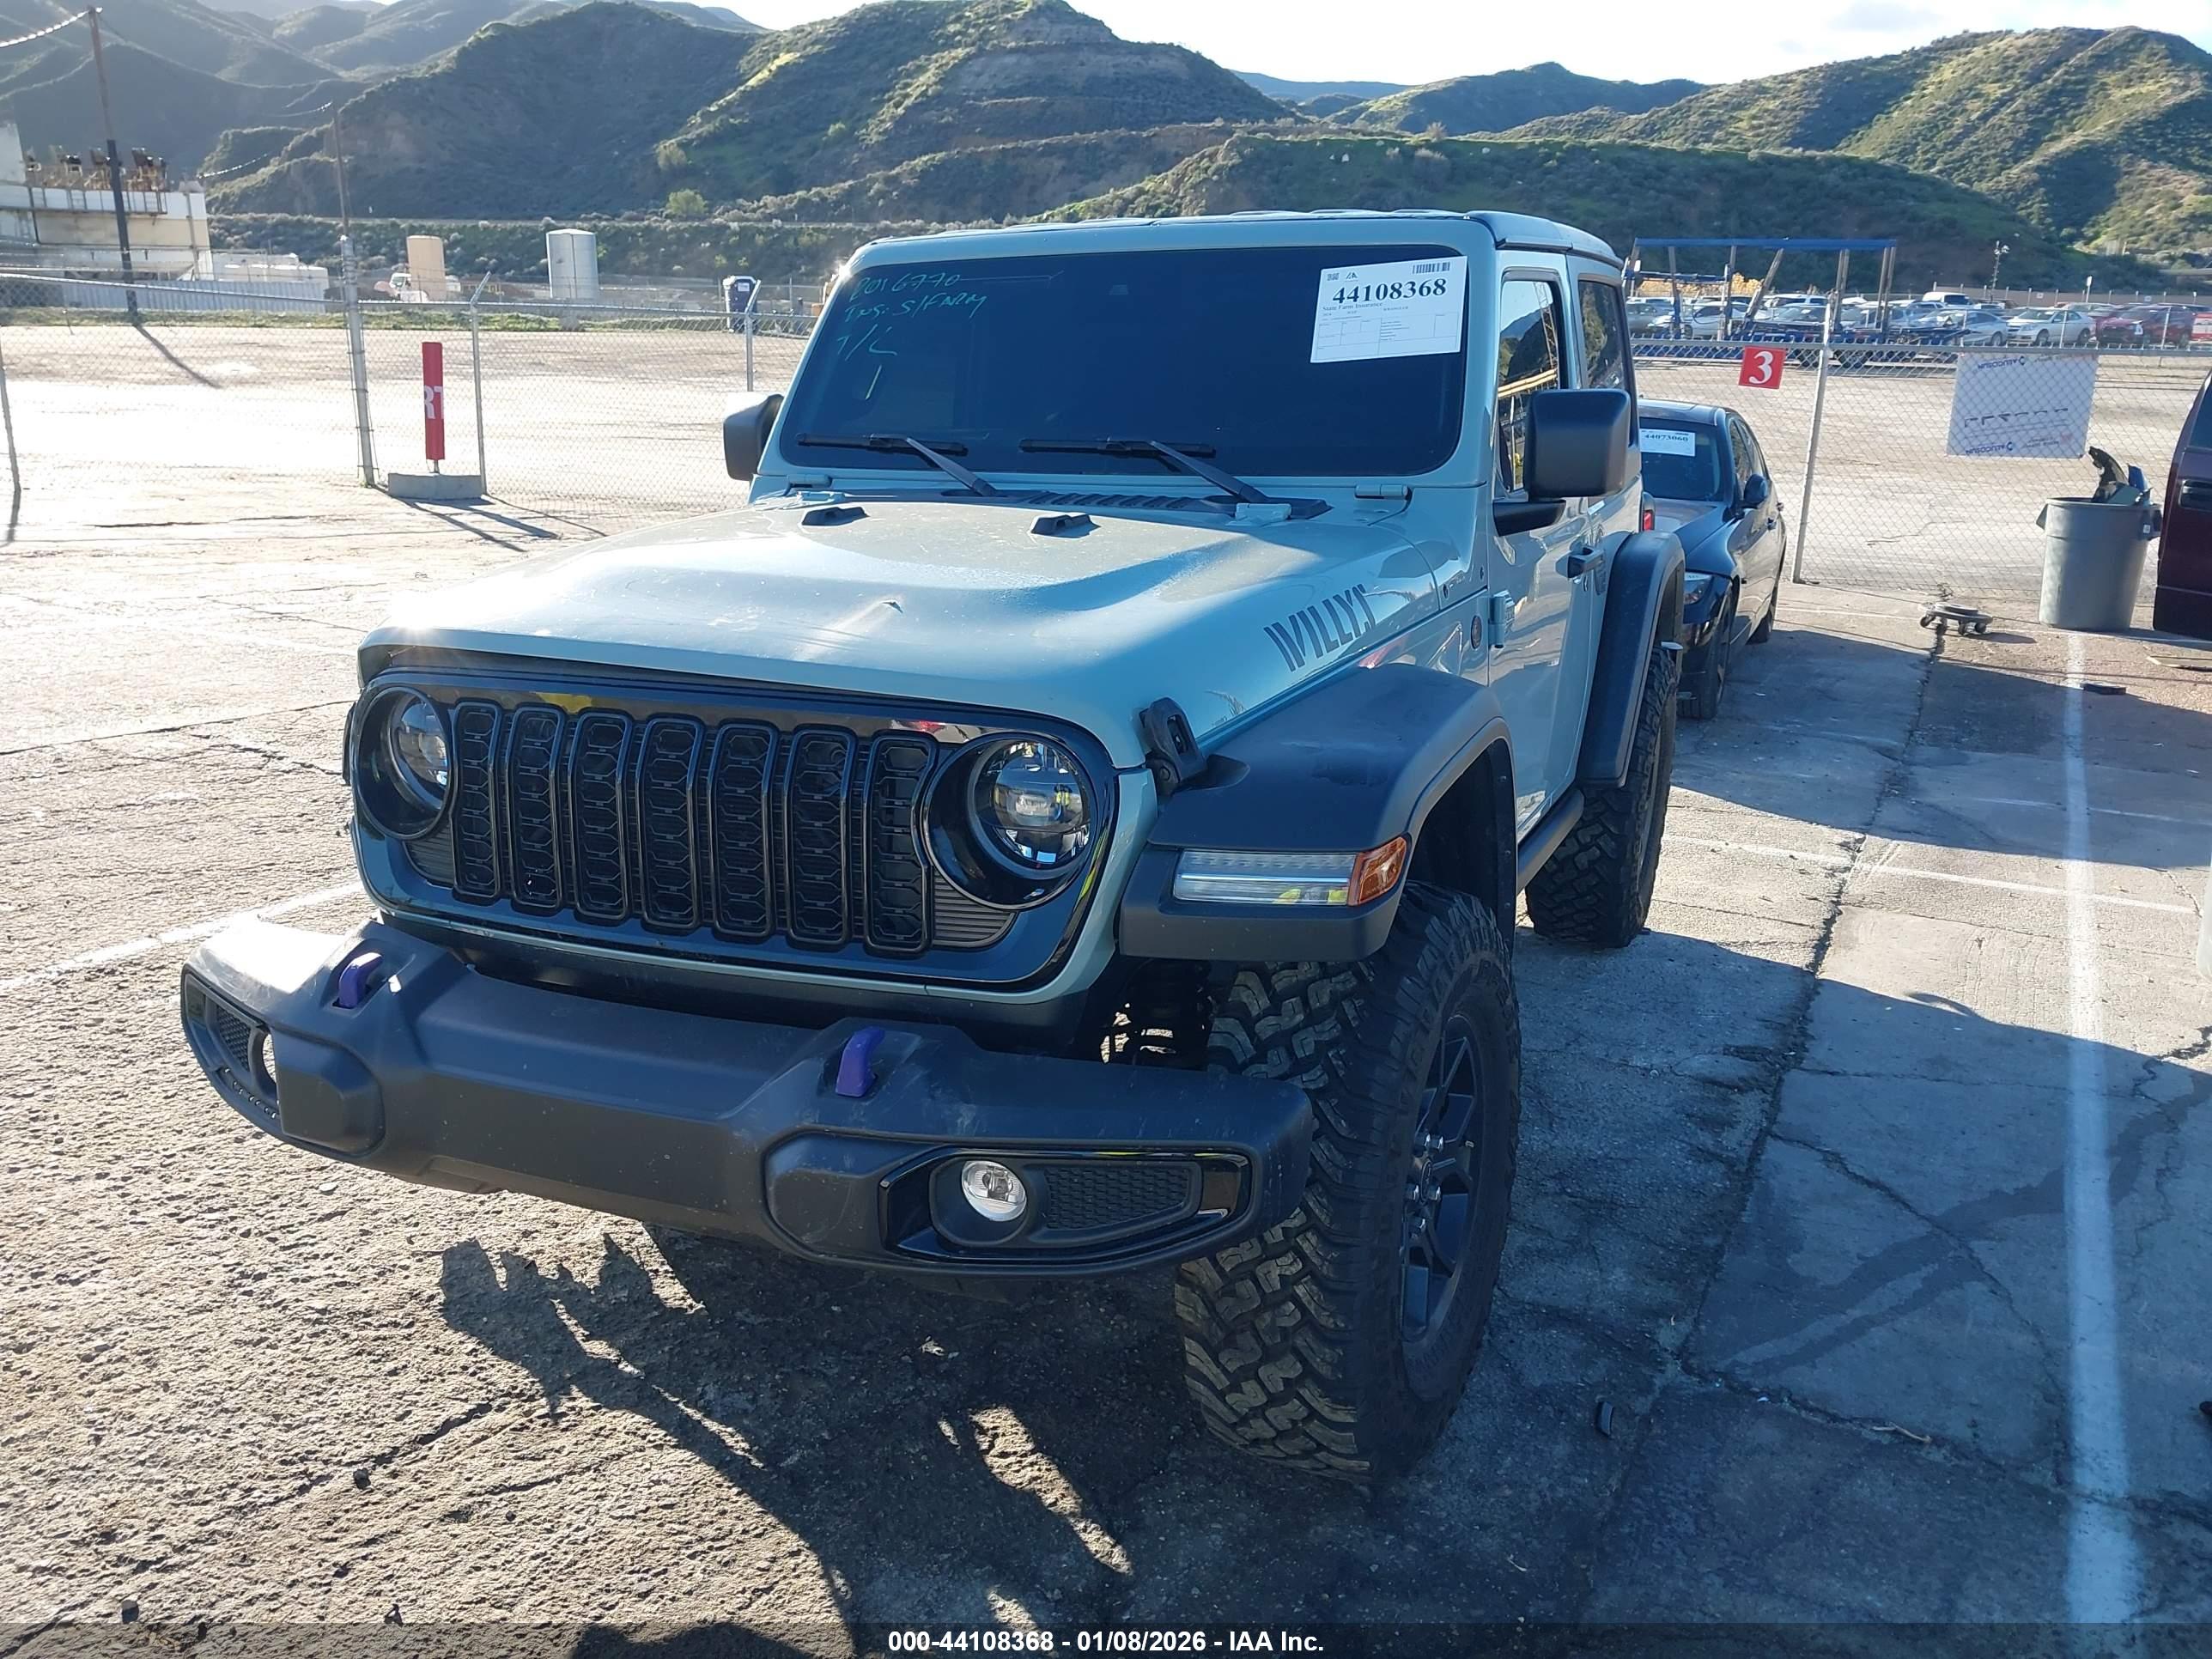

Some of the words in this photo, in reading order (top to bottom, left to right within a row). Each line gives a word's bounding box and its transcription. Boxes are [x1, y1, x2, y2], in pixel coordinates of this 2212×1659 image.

[1332, 278, 1448, 304] 44108368
[1748, 350, 1774, 384] 3
[1263, 583, 1376, 672] WILLYS
